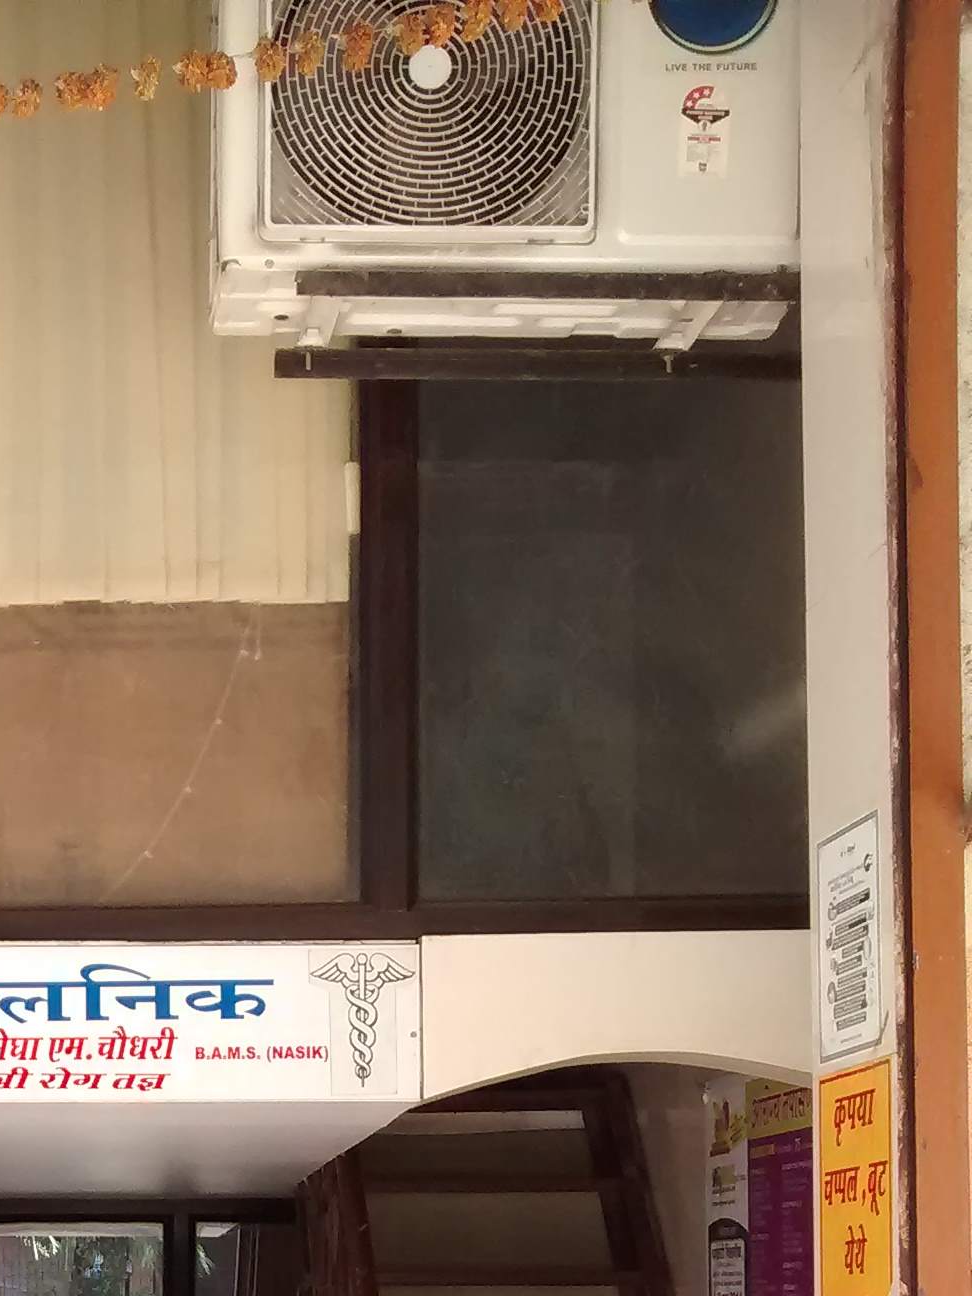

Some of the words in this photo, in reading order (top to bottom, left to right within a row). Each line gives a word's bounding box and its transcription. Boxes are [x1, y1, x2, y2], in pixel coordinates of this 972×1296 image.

[665, 63, 688, 72] LIVE
[692, 63, 713, 72] THE
[716, 62, 758, 72] FUTURE
[195, 1046, 261, 1060] B.A.M.S.
[267, 1045, 329, 1063] (NASIK)
[39, 1066, 108, 1090] रोग
[834, 1088, 876, 1147] कृपया
